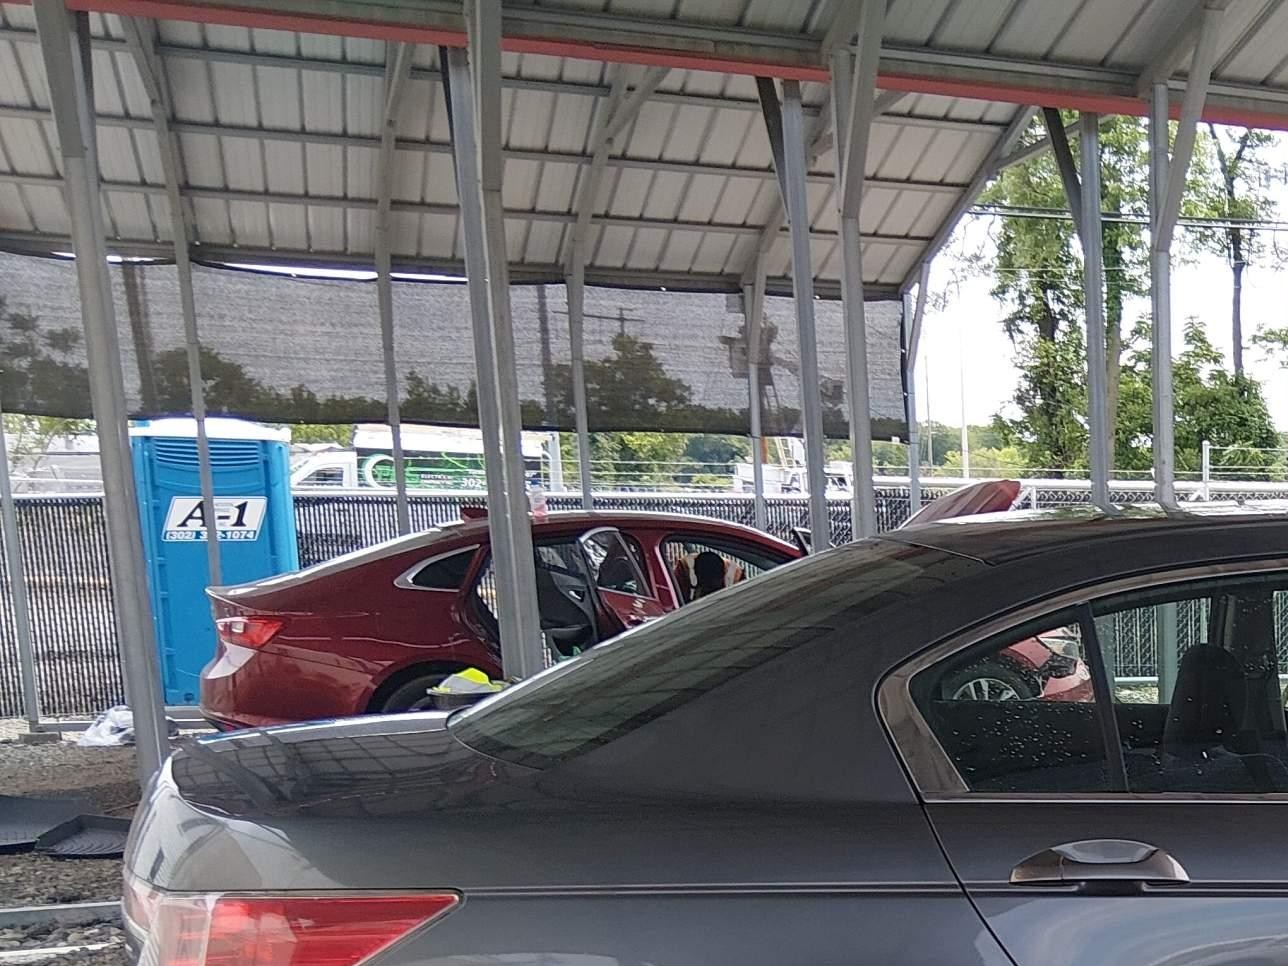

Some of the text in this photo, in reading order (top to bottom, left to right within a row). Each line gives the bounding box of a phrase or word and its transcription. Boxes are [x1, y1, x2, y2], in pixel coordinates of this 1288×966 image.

[177, 501, 248, 528] A-1
[165, 530, 255, 541] (302) 32-1074
